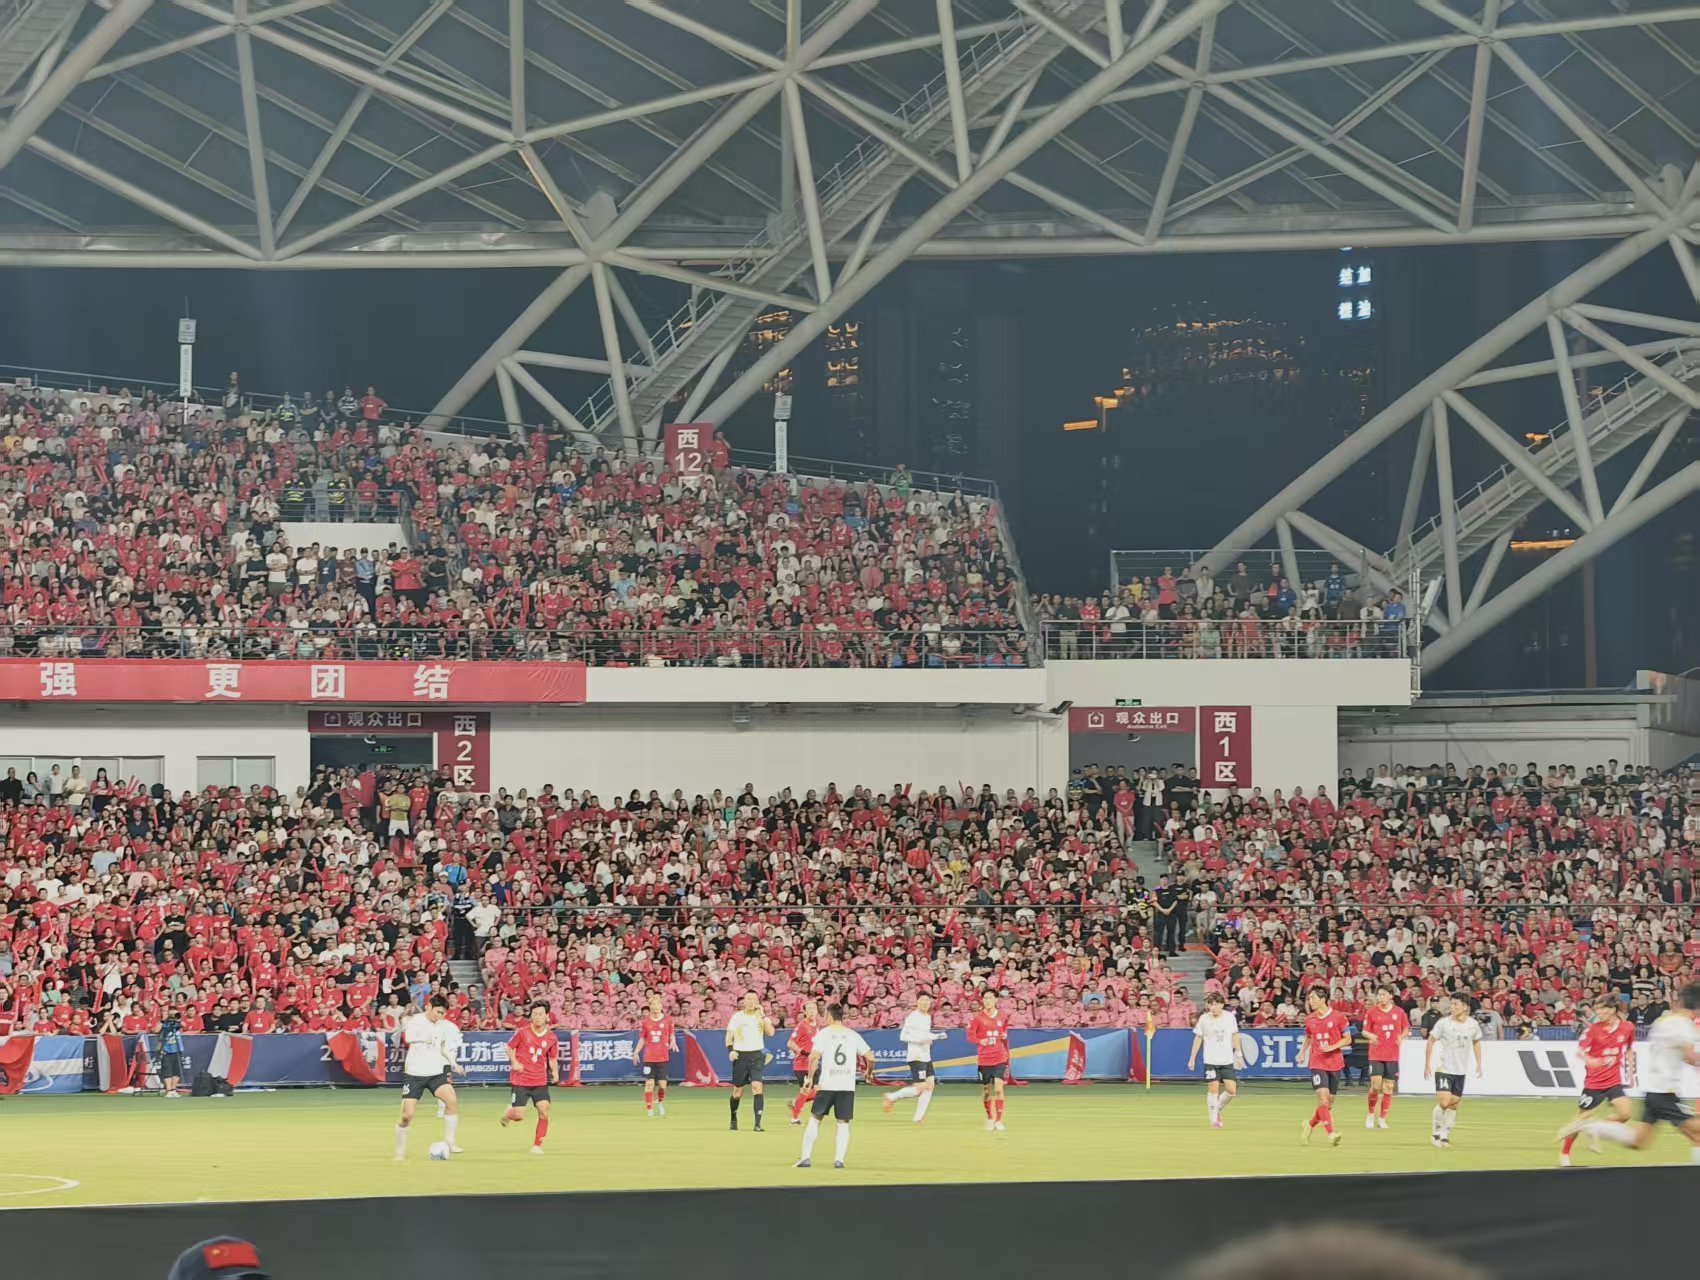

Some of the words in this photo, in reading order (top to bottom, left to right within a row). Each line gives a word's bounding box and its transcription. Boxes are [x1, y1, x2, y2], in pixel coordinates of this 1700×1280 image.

[40, 662, 77, 697] 强
[347, 711, 422, 727] 观众出口
[1115, 711, 1179, 725] 观众出口
[834, 1043, 847, 1066] 6
